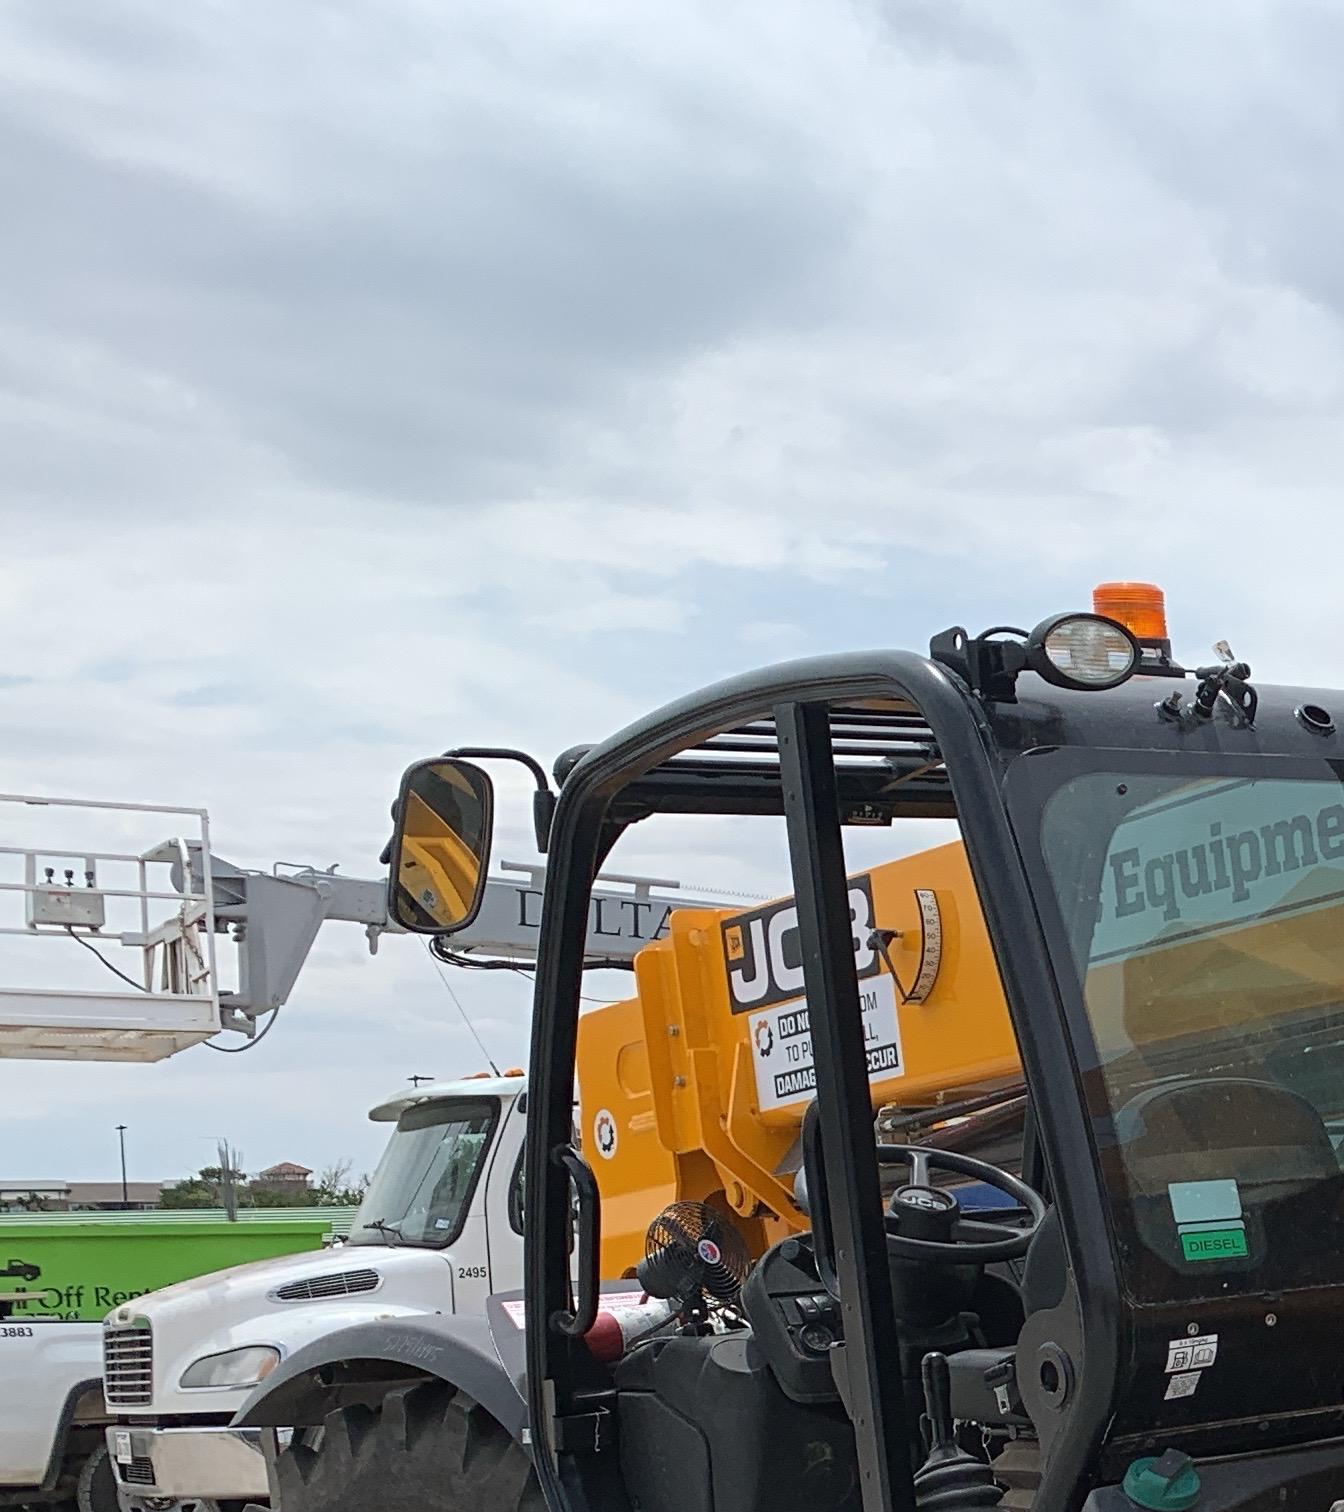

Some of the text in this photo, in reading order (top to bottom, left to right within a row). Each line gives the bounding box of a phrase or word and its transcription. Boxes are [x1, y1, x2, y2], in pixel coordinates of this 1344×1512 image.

[516, 888, 672, 941] DLTA
[780, 1016, 795, 1037] DO
[785, 1044, 799, 1062] TO
[776, 1046, 896, 1095] DAMAG CCUR
[1188, 1238, 1241, 1252] DIESEL
[458, 1266, 487, 1279] 2495
[38, 1286, 84, 1309] Off
